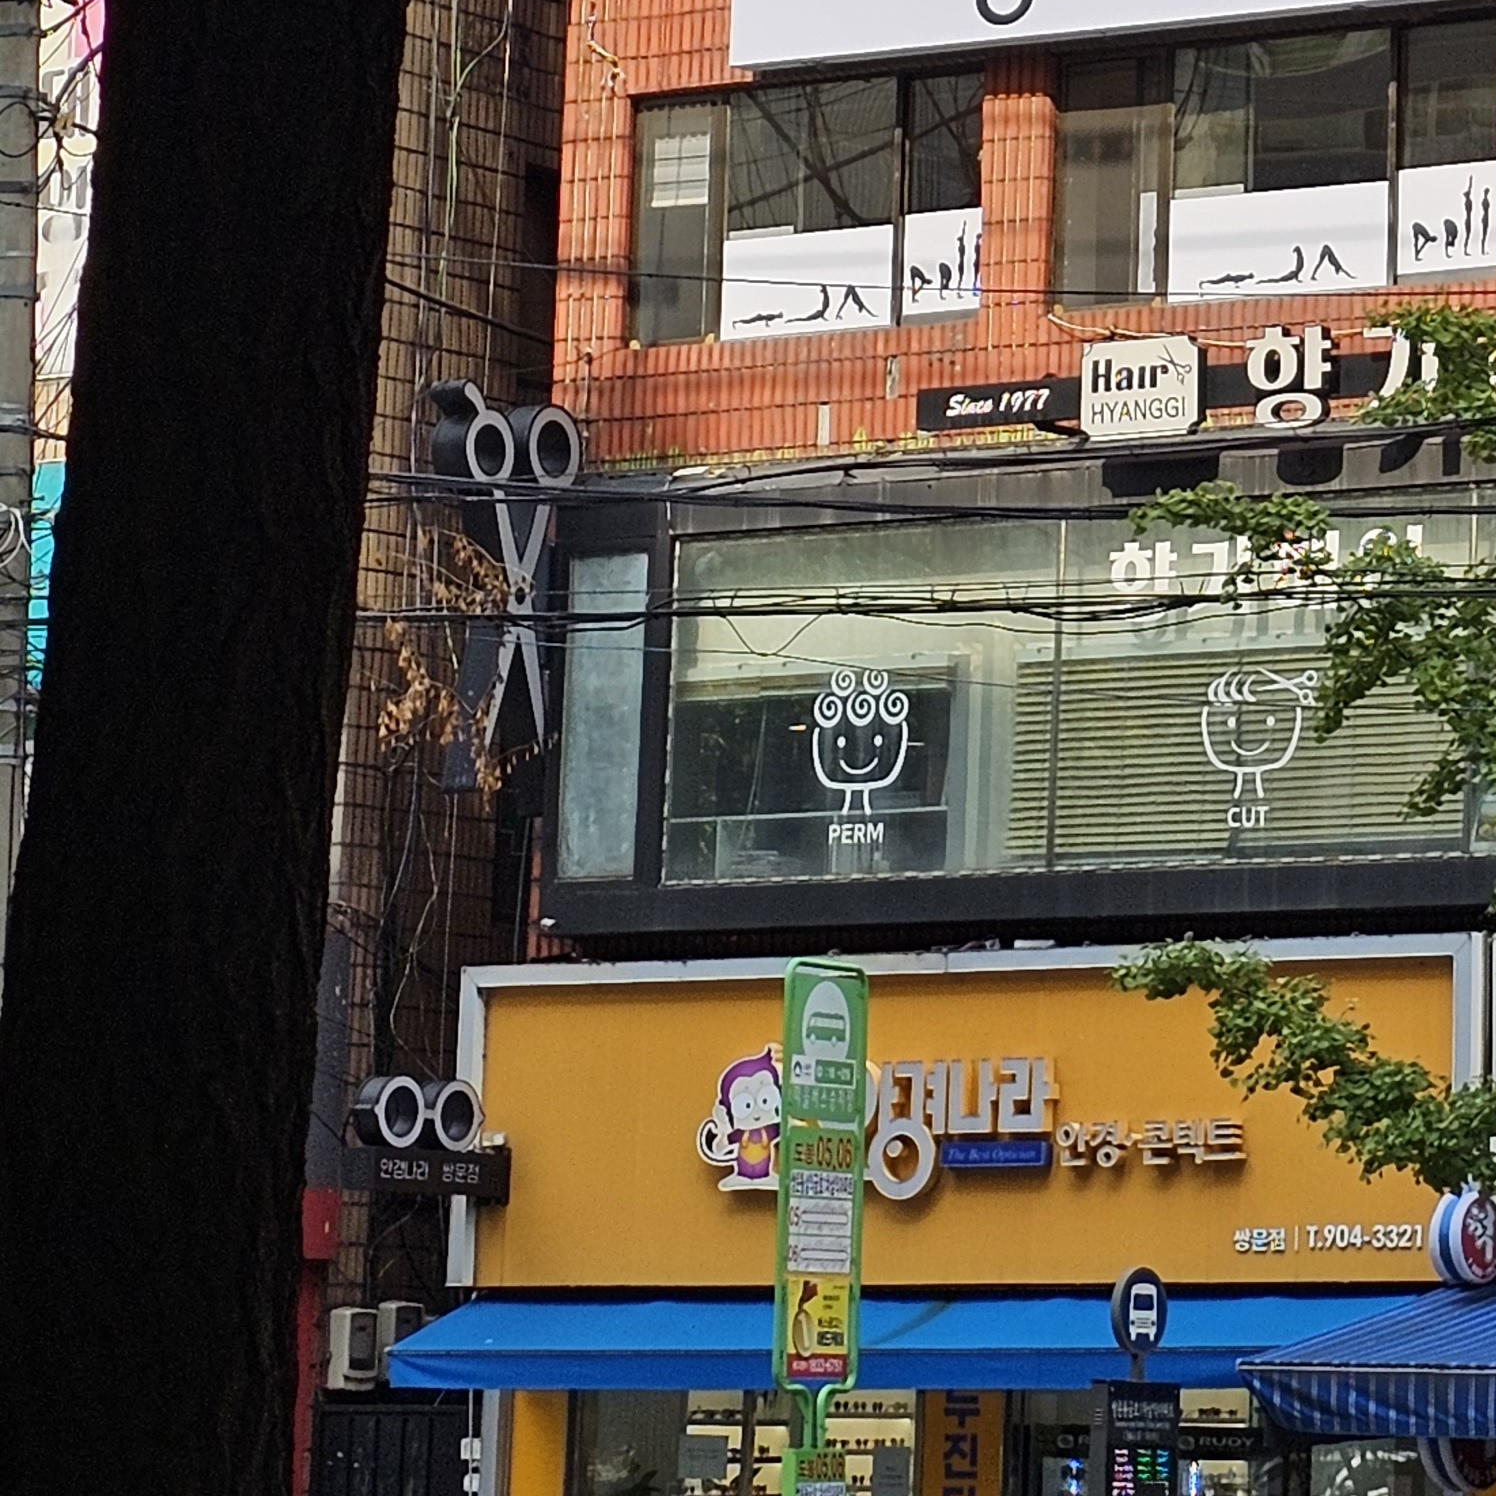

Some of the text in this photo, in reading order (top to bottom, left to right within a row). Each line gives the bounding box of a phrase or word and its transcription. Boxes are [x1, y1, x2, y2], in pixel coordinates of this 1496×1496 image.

[1090, 357, 1169, 394] Hair
[998, 388, 1051, 413] 1977
[1090, 396, 1187, 425] HYANGGI
[1226, 806, 1270, 829] CUT
[827, 822, 885, 846] PERM
[379, 1157, 481, 1185] 안경나라 쌍문점
[1233, 1223, 1425, 1253] 쌍문점 T.904-3321
[1199, 1435, 1255, 1447] RUDY
